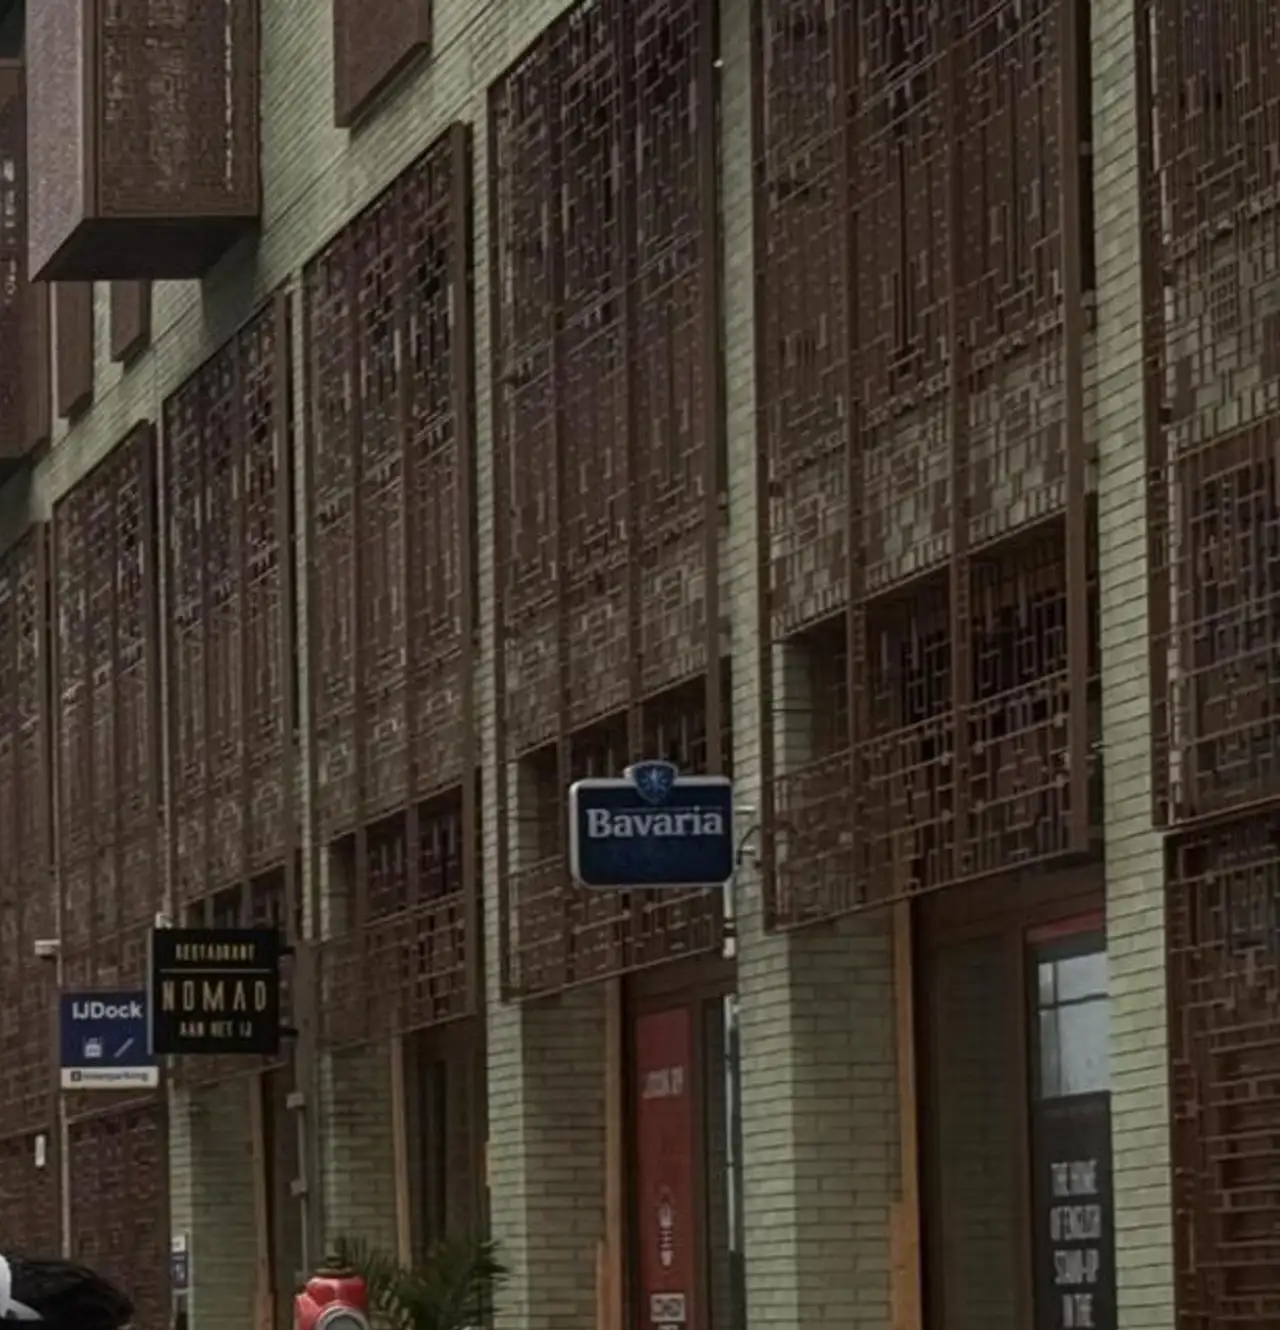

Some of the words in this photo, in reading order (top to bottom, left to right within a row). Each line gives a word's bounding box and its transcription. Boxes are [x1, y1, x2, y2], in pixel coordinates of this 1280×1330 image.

[585, 805, 724, 838] Bavaria
[72, 1000, 143, 1020] IJDock
[161, 980, 267, 1012] NOMAD
